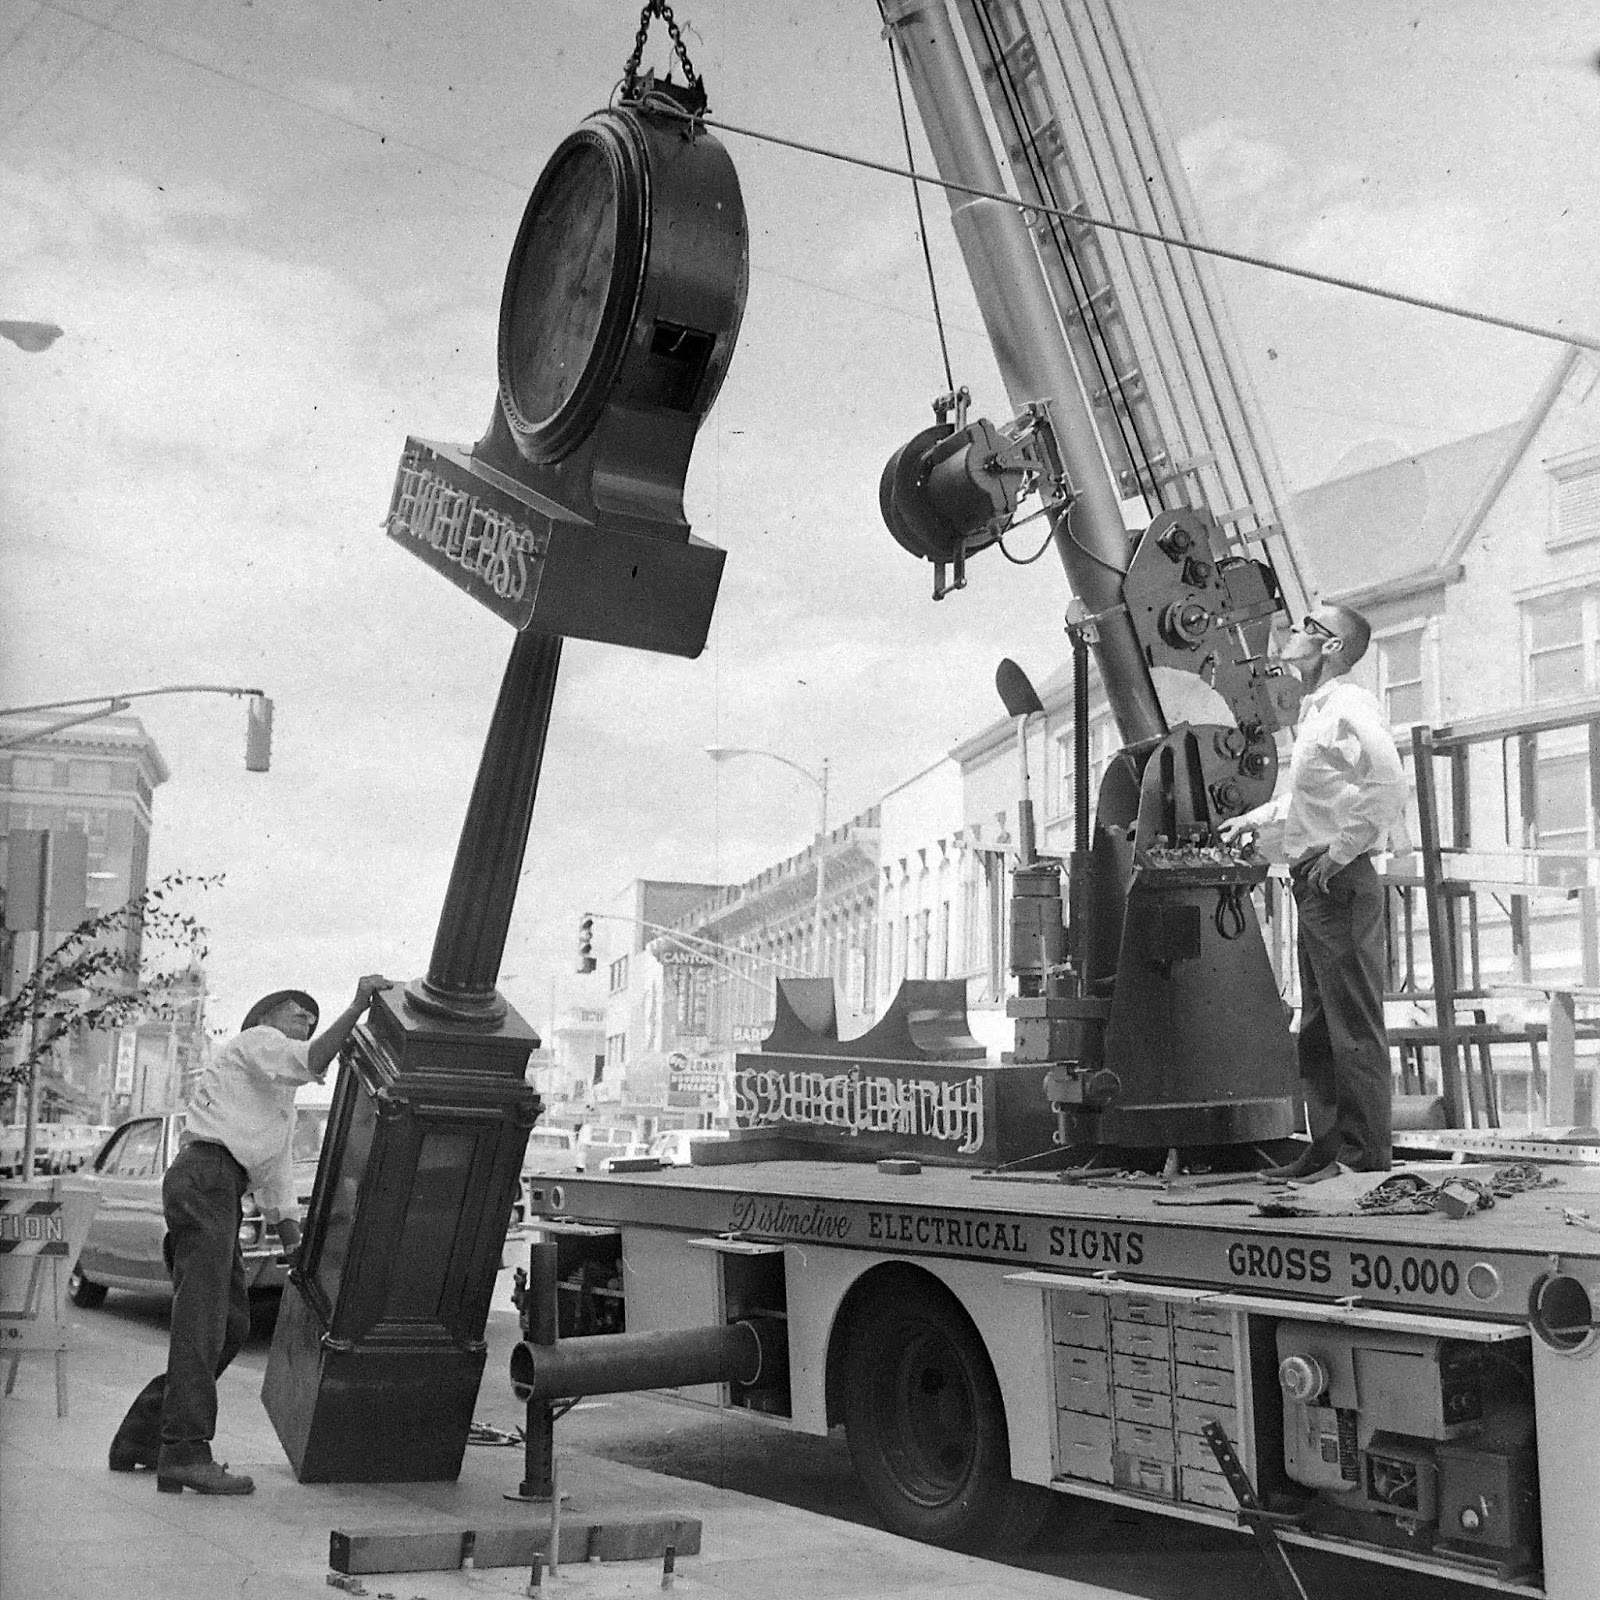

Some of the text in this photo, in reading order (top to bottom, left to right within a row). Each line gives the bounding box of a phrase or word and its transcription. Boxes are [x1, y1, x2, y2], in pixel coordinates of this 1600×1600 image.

[663, 952, 711, 964] CANTO
[729, 1195, 1144, 1265] Distinctive ELECTRICAL SIGNS
[1228, 1243, 1459, 1295] GROSS 30,000
